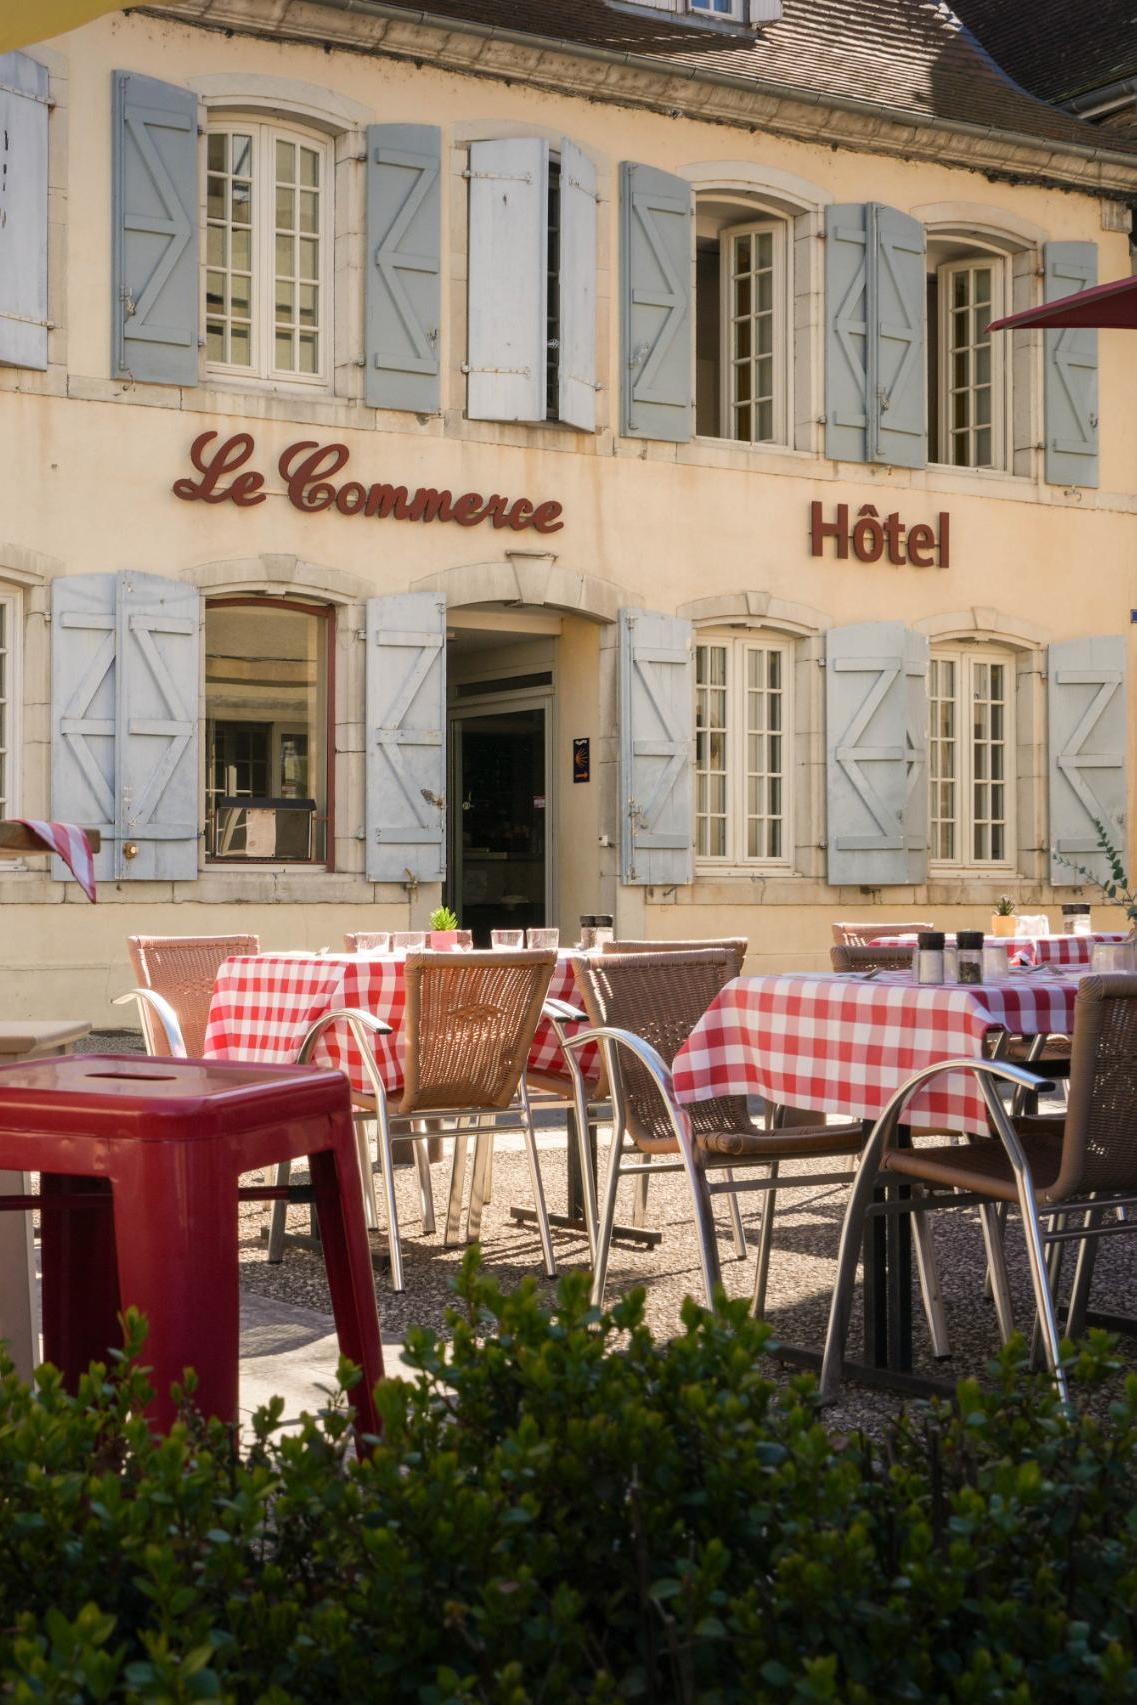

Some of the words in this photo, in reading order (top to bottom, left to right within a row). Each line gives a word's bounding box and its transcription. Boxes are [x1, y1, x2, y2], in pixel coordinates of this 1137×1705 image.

[172, 430, 266, 507] Le
[278, 440, 565, 534] Commerce
[811, 500, 950, 569] Hôtel
